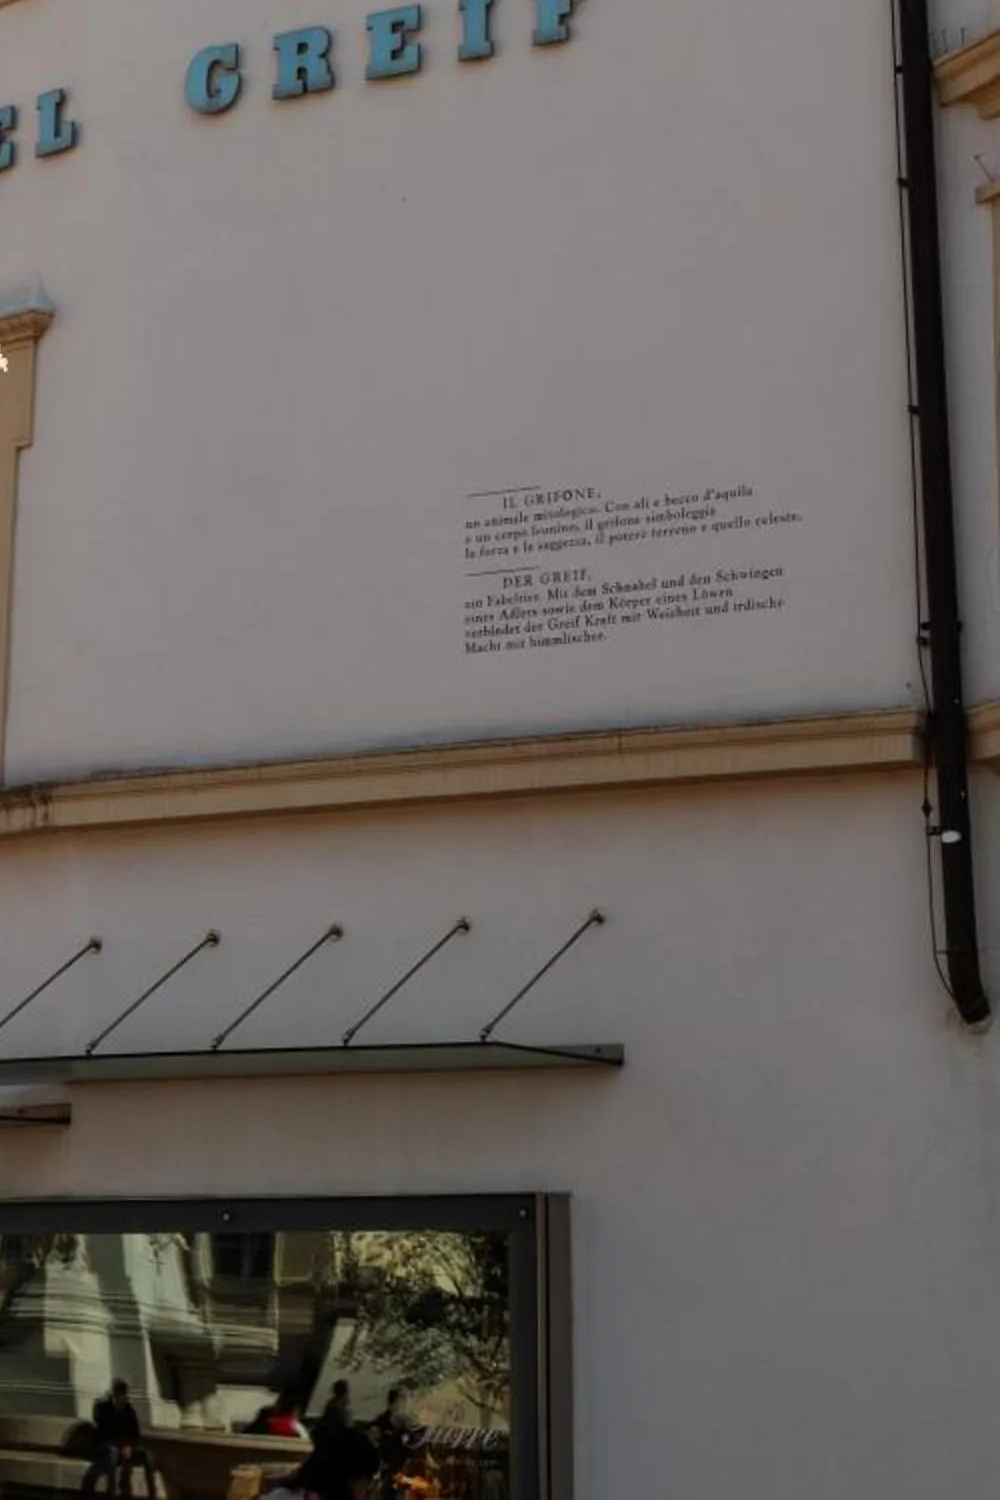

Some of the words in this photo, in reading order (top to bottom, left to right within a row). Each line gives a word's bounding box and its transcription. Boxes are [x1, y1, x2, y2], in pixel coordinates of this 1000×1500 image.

[465, 520, 481, 529] un
[484, 512, 528, 526] animale
[605, 501, 630, 513] Con
[634, 496, 649, 509] ali
[665, 493, 699, 506] becco
[502, 496, 518, 510] IL
[465, 548, 475, 560] la
[479, 545, 509, 557] forza
[523, 541, 534, 553] la
[596, 533, 604, 546] il
[609, 532, 647, 546] potere
[651, 527, 697, 539] terreno
[711, 515, 751, 533] quello
[475, 534, 491, 543] un
[495, 530, 528, 542] corpo
[586, 518, 593, 531] il
[597, 515, 640, 531] grifone
[645, 505, 717, 523] simboleggia
[464, 598, 483, 610] ein
[547, 587, 568, 601] Mit
[574, 586, 597, 598] dem
[601, 577, 657, 595] Schnabel
[661, 574, 685, 589] und
[689, 572, 711, 586] den
[715, 566, 783, 583] Schwingen
[503, 575, 533, 588] DER
[464, 612, 495, 624] eines
[543, 602, 575, 615] sowie
[579, 599, 604, 612] dem
[655, 592, 688, 605] eines
[464, 624, 520, 639] verbindet
[523, 621, 543, 635] der
[548, 614, 580, 631] Greif
[584, 612, 617, 627] Kraft
[621, 611, 642, 624] mit
[646, 604, 700, 620] Weisheit
[705, 600, 729, 615] und
[464, 639, 501, 654] Macht
[505, 637, 525, 650] mit
